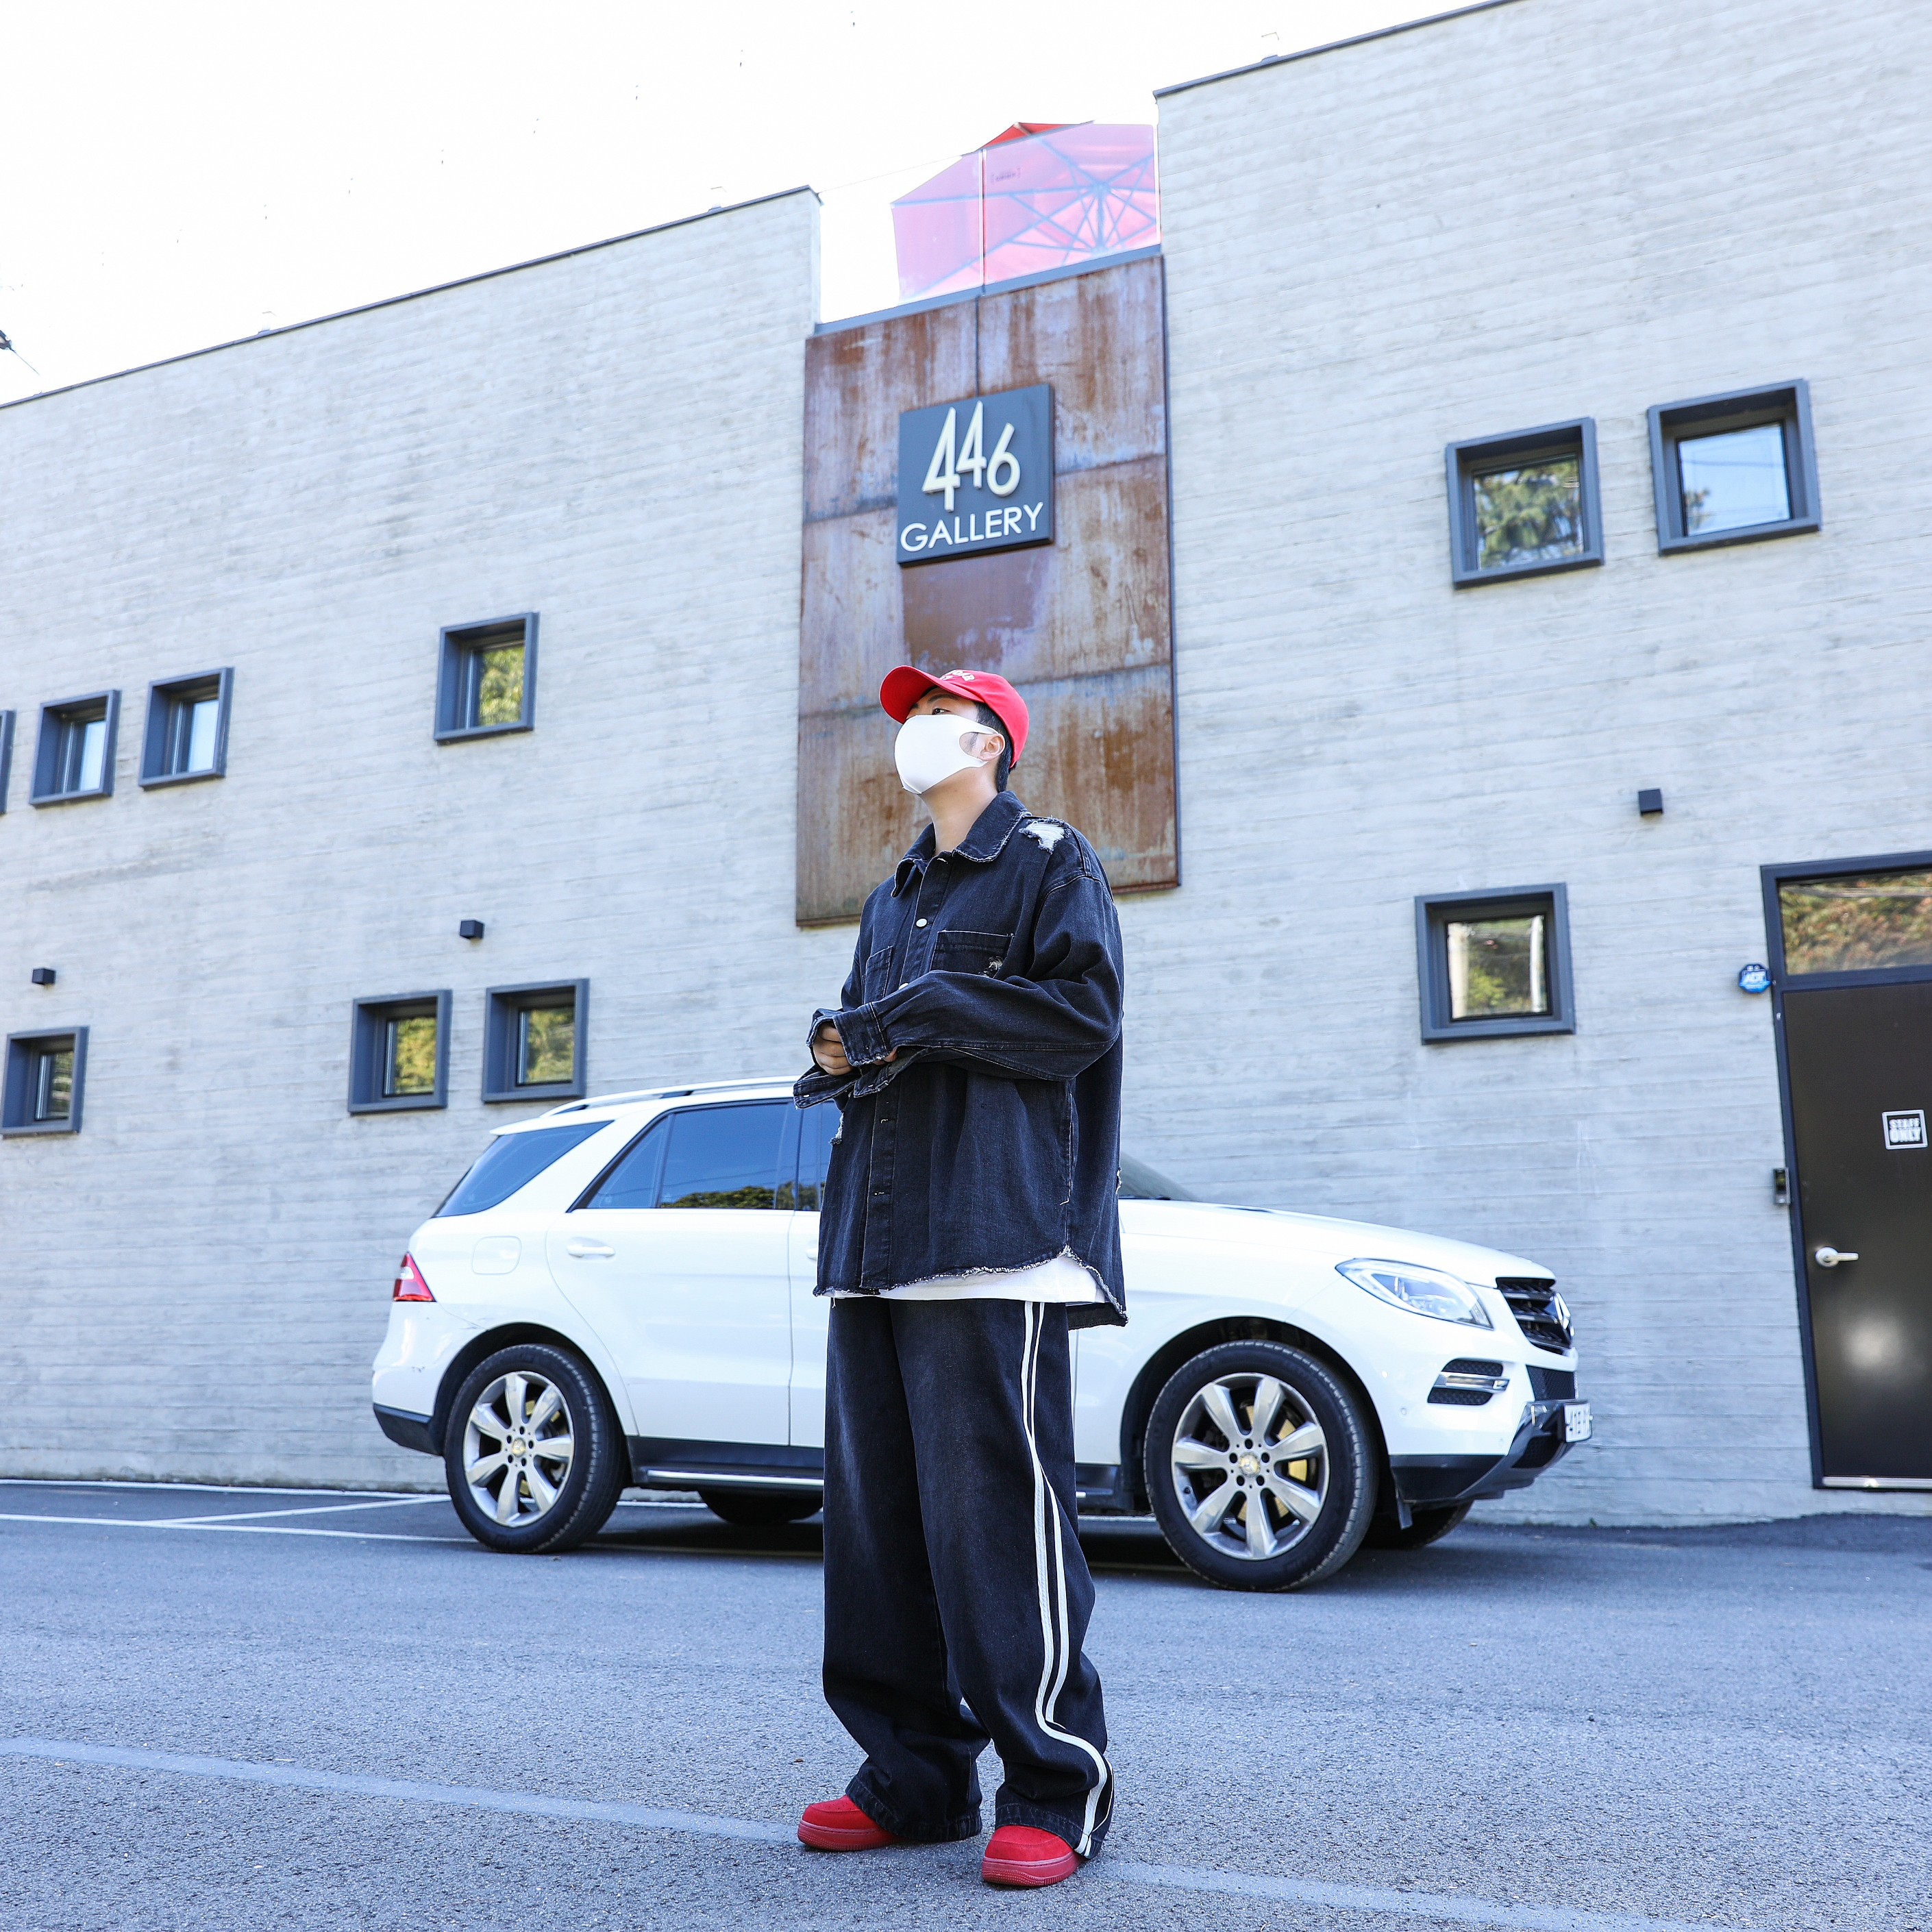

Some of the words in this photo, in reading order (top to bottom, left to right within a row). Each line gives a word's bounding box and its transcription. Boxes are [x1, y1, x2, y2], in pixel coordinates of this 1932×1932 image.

[922, 399, 1021, 512] 446
[900, 502, 1044, 552] GALLERY
[1889, 1117, 1920, 1128] STAFF
[1889, 1127, 1922, 1143] ONLY
